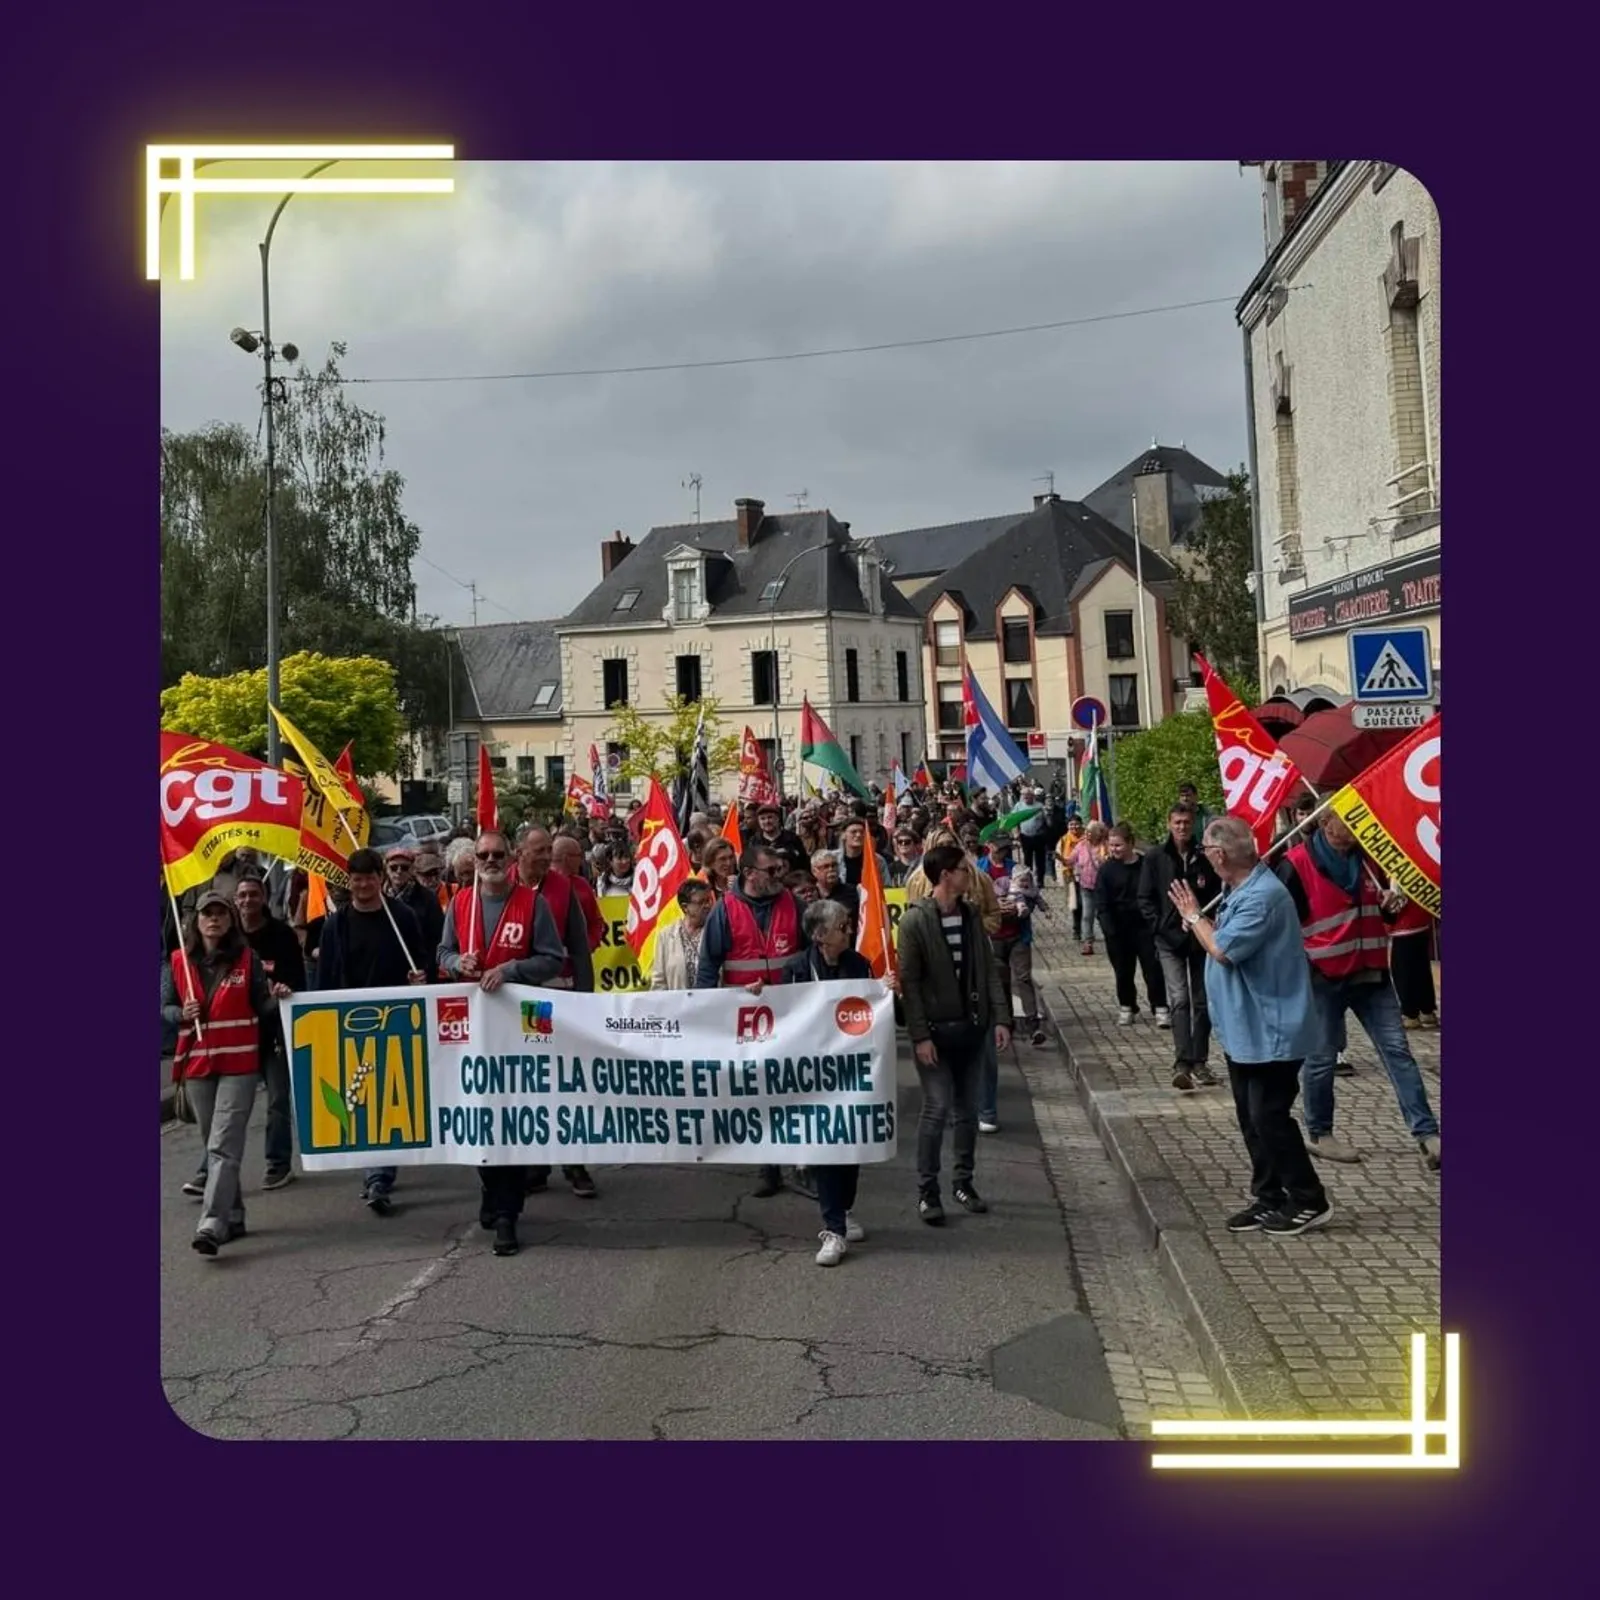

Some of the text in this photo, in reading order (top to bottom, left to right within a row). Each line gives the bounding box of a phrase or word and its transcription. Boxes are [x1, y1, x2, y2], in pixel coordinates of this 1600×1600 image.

[1335, 588, 1391, 623] CHARCUTERIE
[1366, 705, 1421, 716] PASSAGE
[161, 767, 287, 827] cgt
[1344, 803, 1359, 831] UL
[246, 829, 260, 839] 44
[500, 922, 524, 943] FO
[438, 1017, 470, 1039] cgt
[605, 1017, 662, 1031] Solidaires
[664, 1019, 681, 1033] 44
[737, 1005, 774, 1040] FO
[461, 1053, 874, 1098] CONTRE LA GUERRE ET LE RACISME
[438, 1101, 895, 1147] POUR NOS SALAIRES ET NOS RETRAITES
